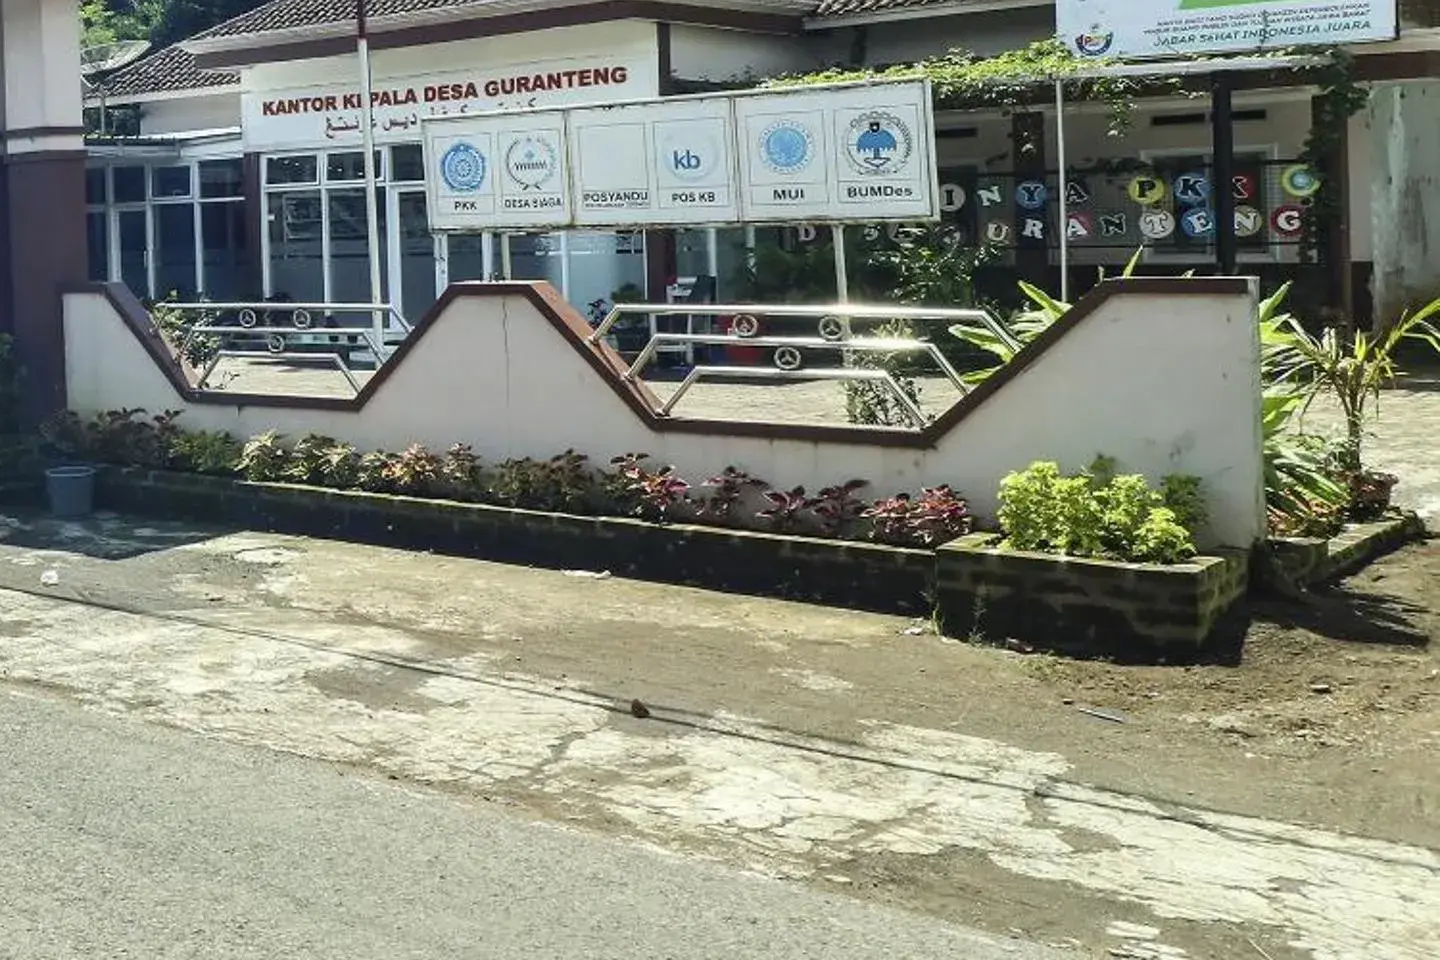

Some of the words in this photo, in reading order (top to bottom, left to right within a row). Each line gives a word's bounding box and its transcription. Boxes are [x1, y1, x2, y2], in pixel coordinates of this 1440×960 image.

[1322, 20, 1372, 33] JUARA
[262, 94, 337, 116] KANTOR
[424, 81, 478, 103] DESA
[483, 66, 628, 97] GURANTENG
[673, 148, 701, 170] kb
[583, 191, 648, 202] POSYANDU
[672, 192, 696, 203] POS
[699, 191, 716, 202] KB
[773, 189, 805, 201] MUI
[848, 186, 913, 198] BUMDes
[454, 200, 478, 211] PKK
[505, 198, 531, 208] DESA
